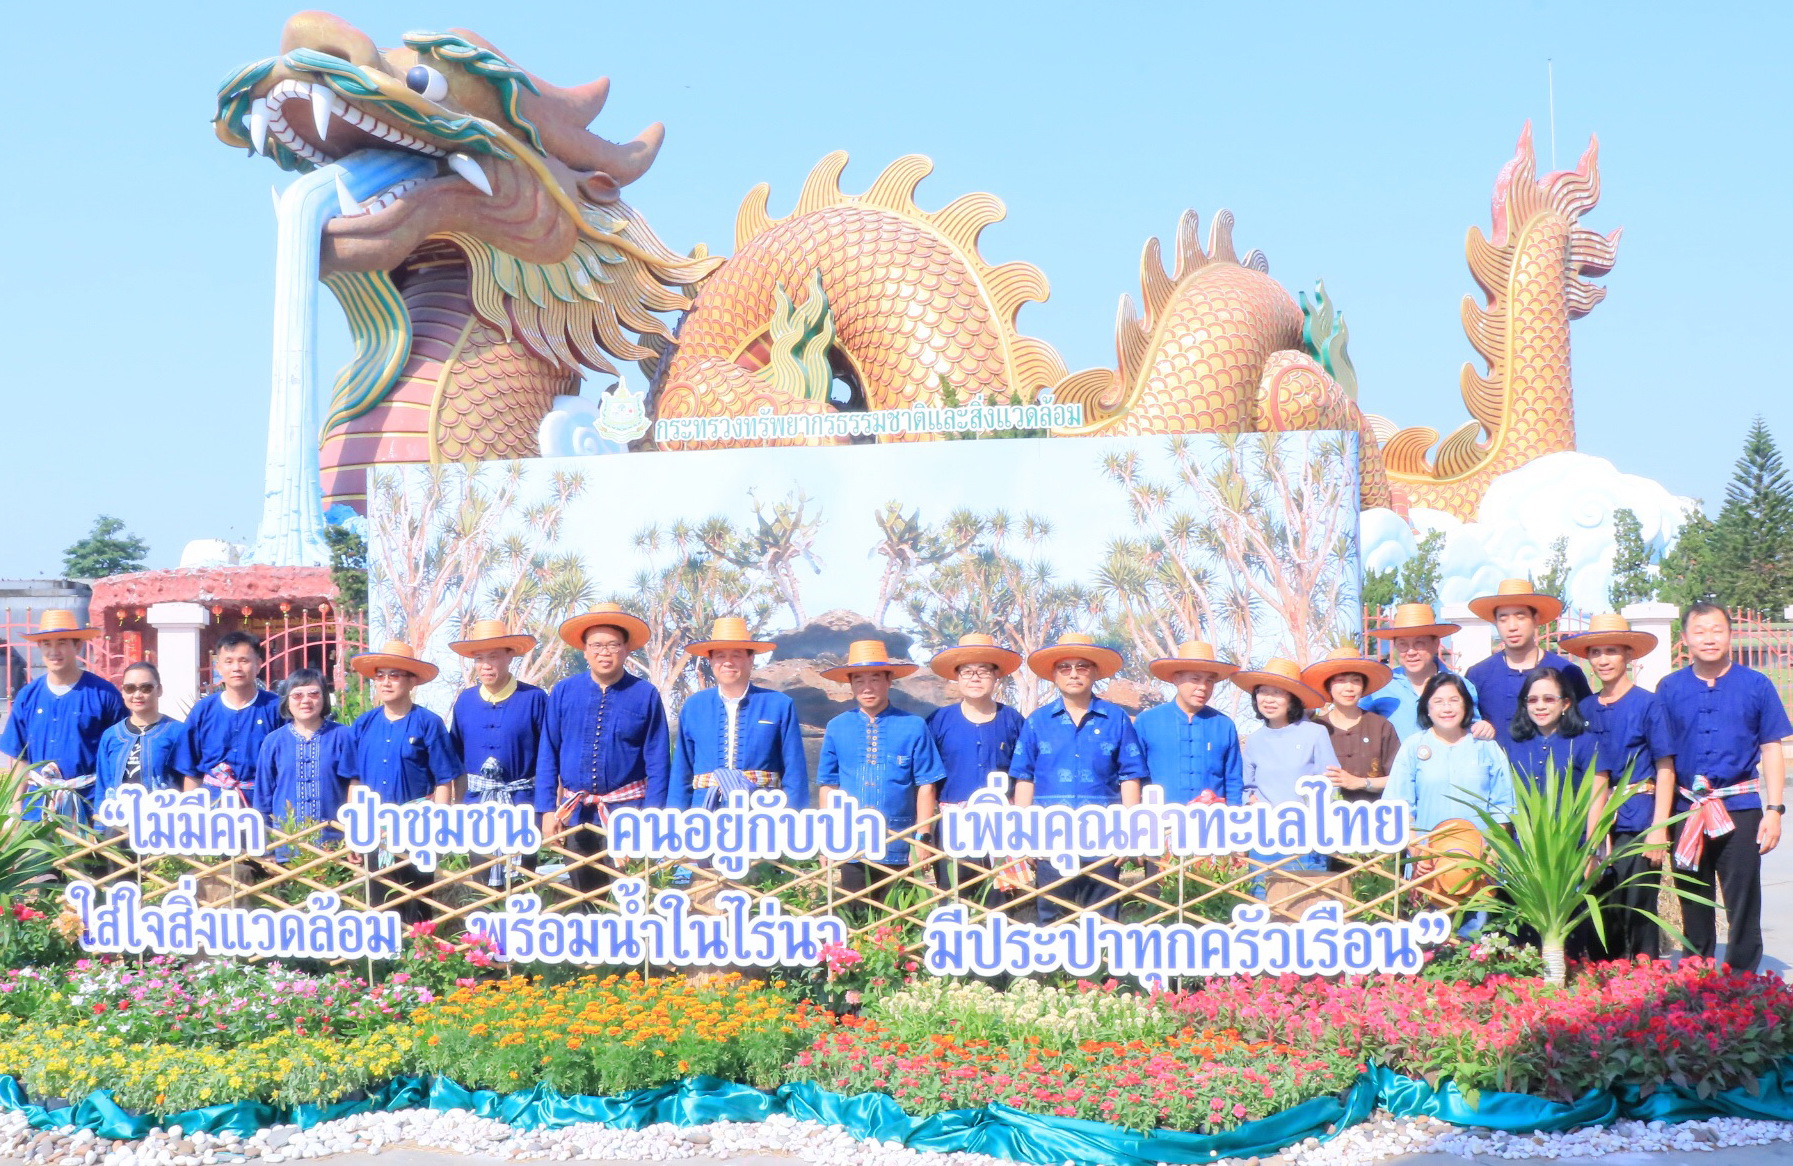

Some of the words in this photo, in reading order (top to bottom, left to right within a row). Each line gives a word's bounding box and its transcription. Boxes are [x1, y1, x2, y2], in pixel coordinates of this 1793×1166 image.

[656, 396, 1081, 440] กระทรวงทรัพยากรธรรมชาติและสิ่งแวดล้อม
[344, 791, 536, 865] ป่าชุมชน
[612, 793, 887, 872] คนอยู่กับป่า
[949, 776, 1403, 871] เพิ่มคุณค่าทะเลไทย
[70, 881, 397, 953] ใส่ใจสิ่งแวดล้อม
